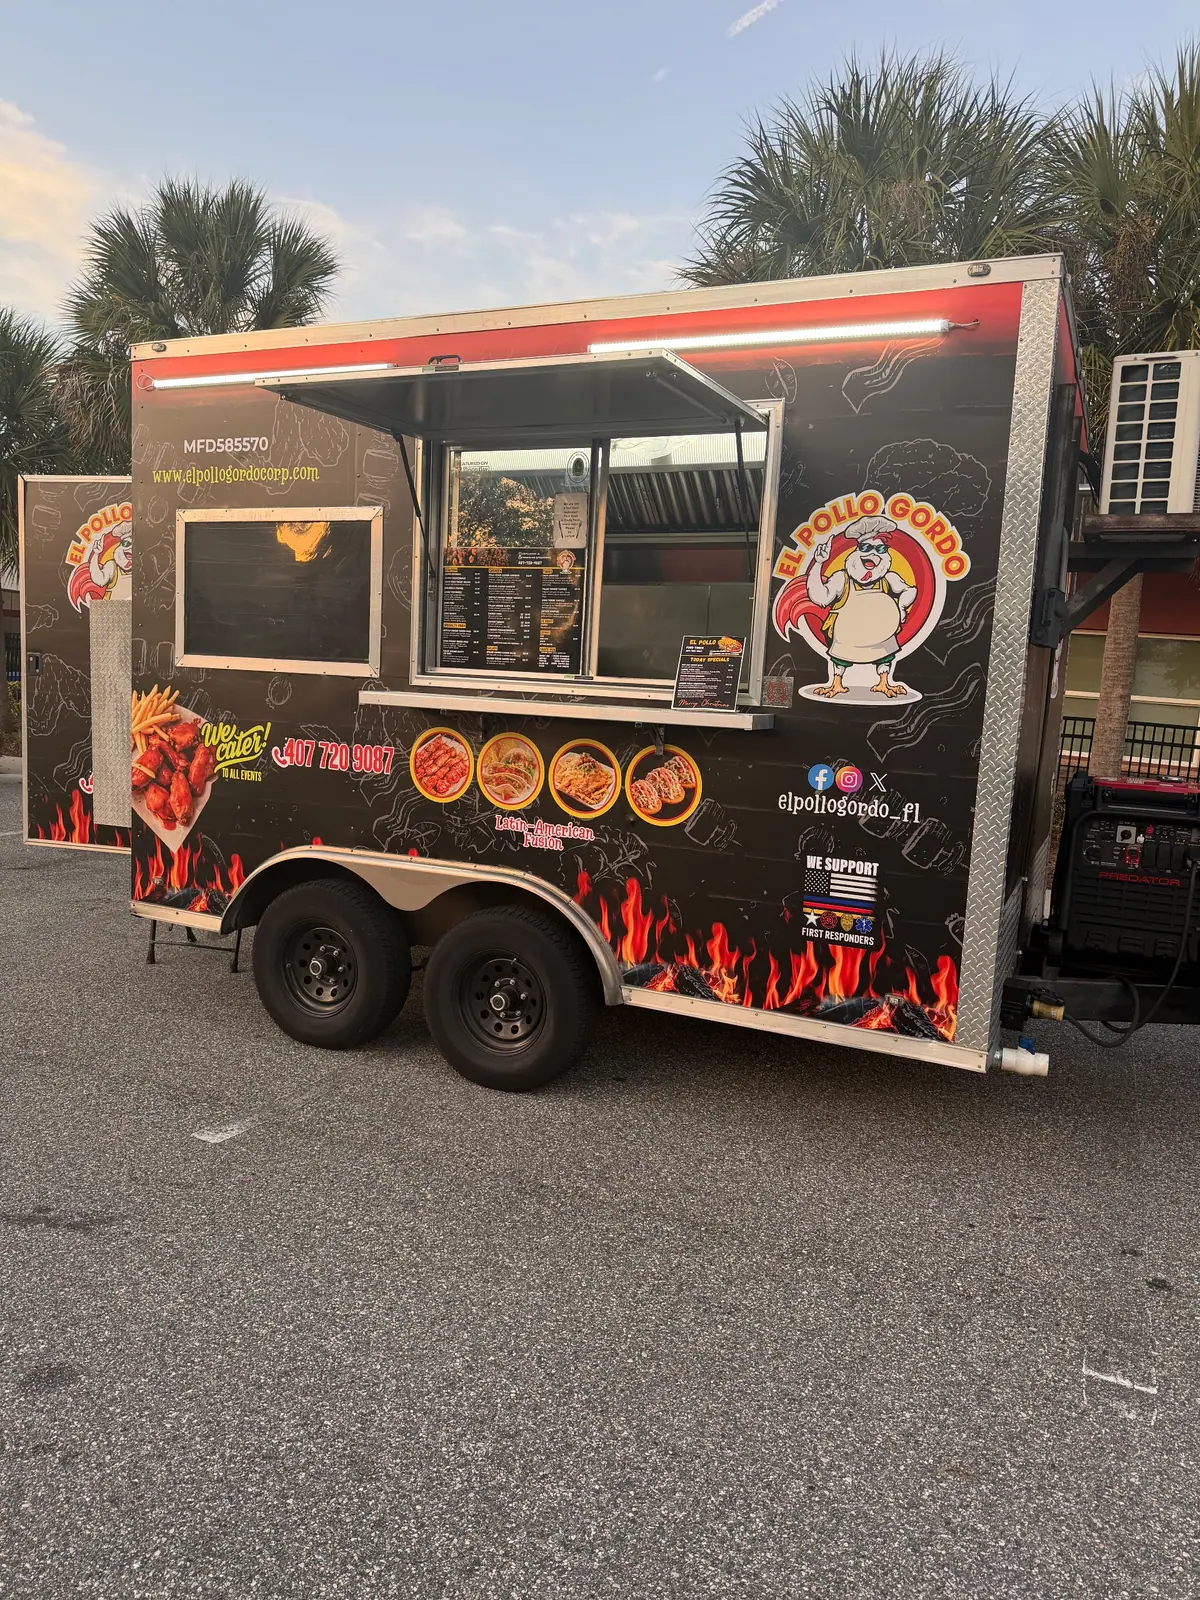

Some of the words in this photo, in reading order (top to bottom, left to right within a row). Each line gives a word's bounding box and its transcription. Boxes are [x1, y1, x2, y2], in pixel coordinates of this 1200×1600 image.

[184, 437, 269, 453] MFD585570
[152, 465, 320, 487] www.elpollogordocorp.com
[69, 544, 87, 564] EL
[80, 504, 132, 541] POLLO
[777, 550, 803, 577] EL
[798, 494, 880, 548] POLLO
[889, 497, 965, 576] GORDO
[679, 699, 698, 708] Merry
[201, 721, 236, 748] We
[214, 721, 272, 762] cater!
[284, 738, 315, 767] 407
[319, 741, 349, 771] 720
[352, 744, 395, 774] 9087
[222, 767, 229, 779] TO
[229, 768, 240, 780] ALL
[240, 770, 262, 782] EVENTS
[778, 792, 920, 823] elpollogordo_fl
[523, 832, 564, 851] Fusion
[806, 855, 823, 870] WE
[825, 858, 879, 877] SUPPORT
[1098, 872, 1181, 887] PREDATOR
[802, 927, 824, 939] FIRST
[825, 930, 875, 946] RESPONDERS
